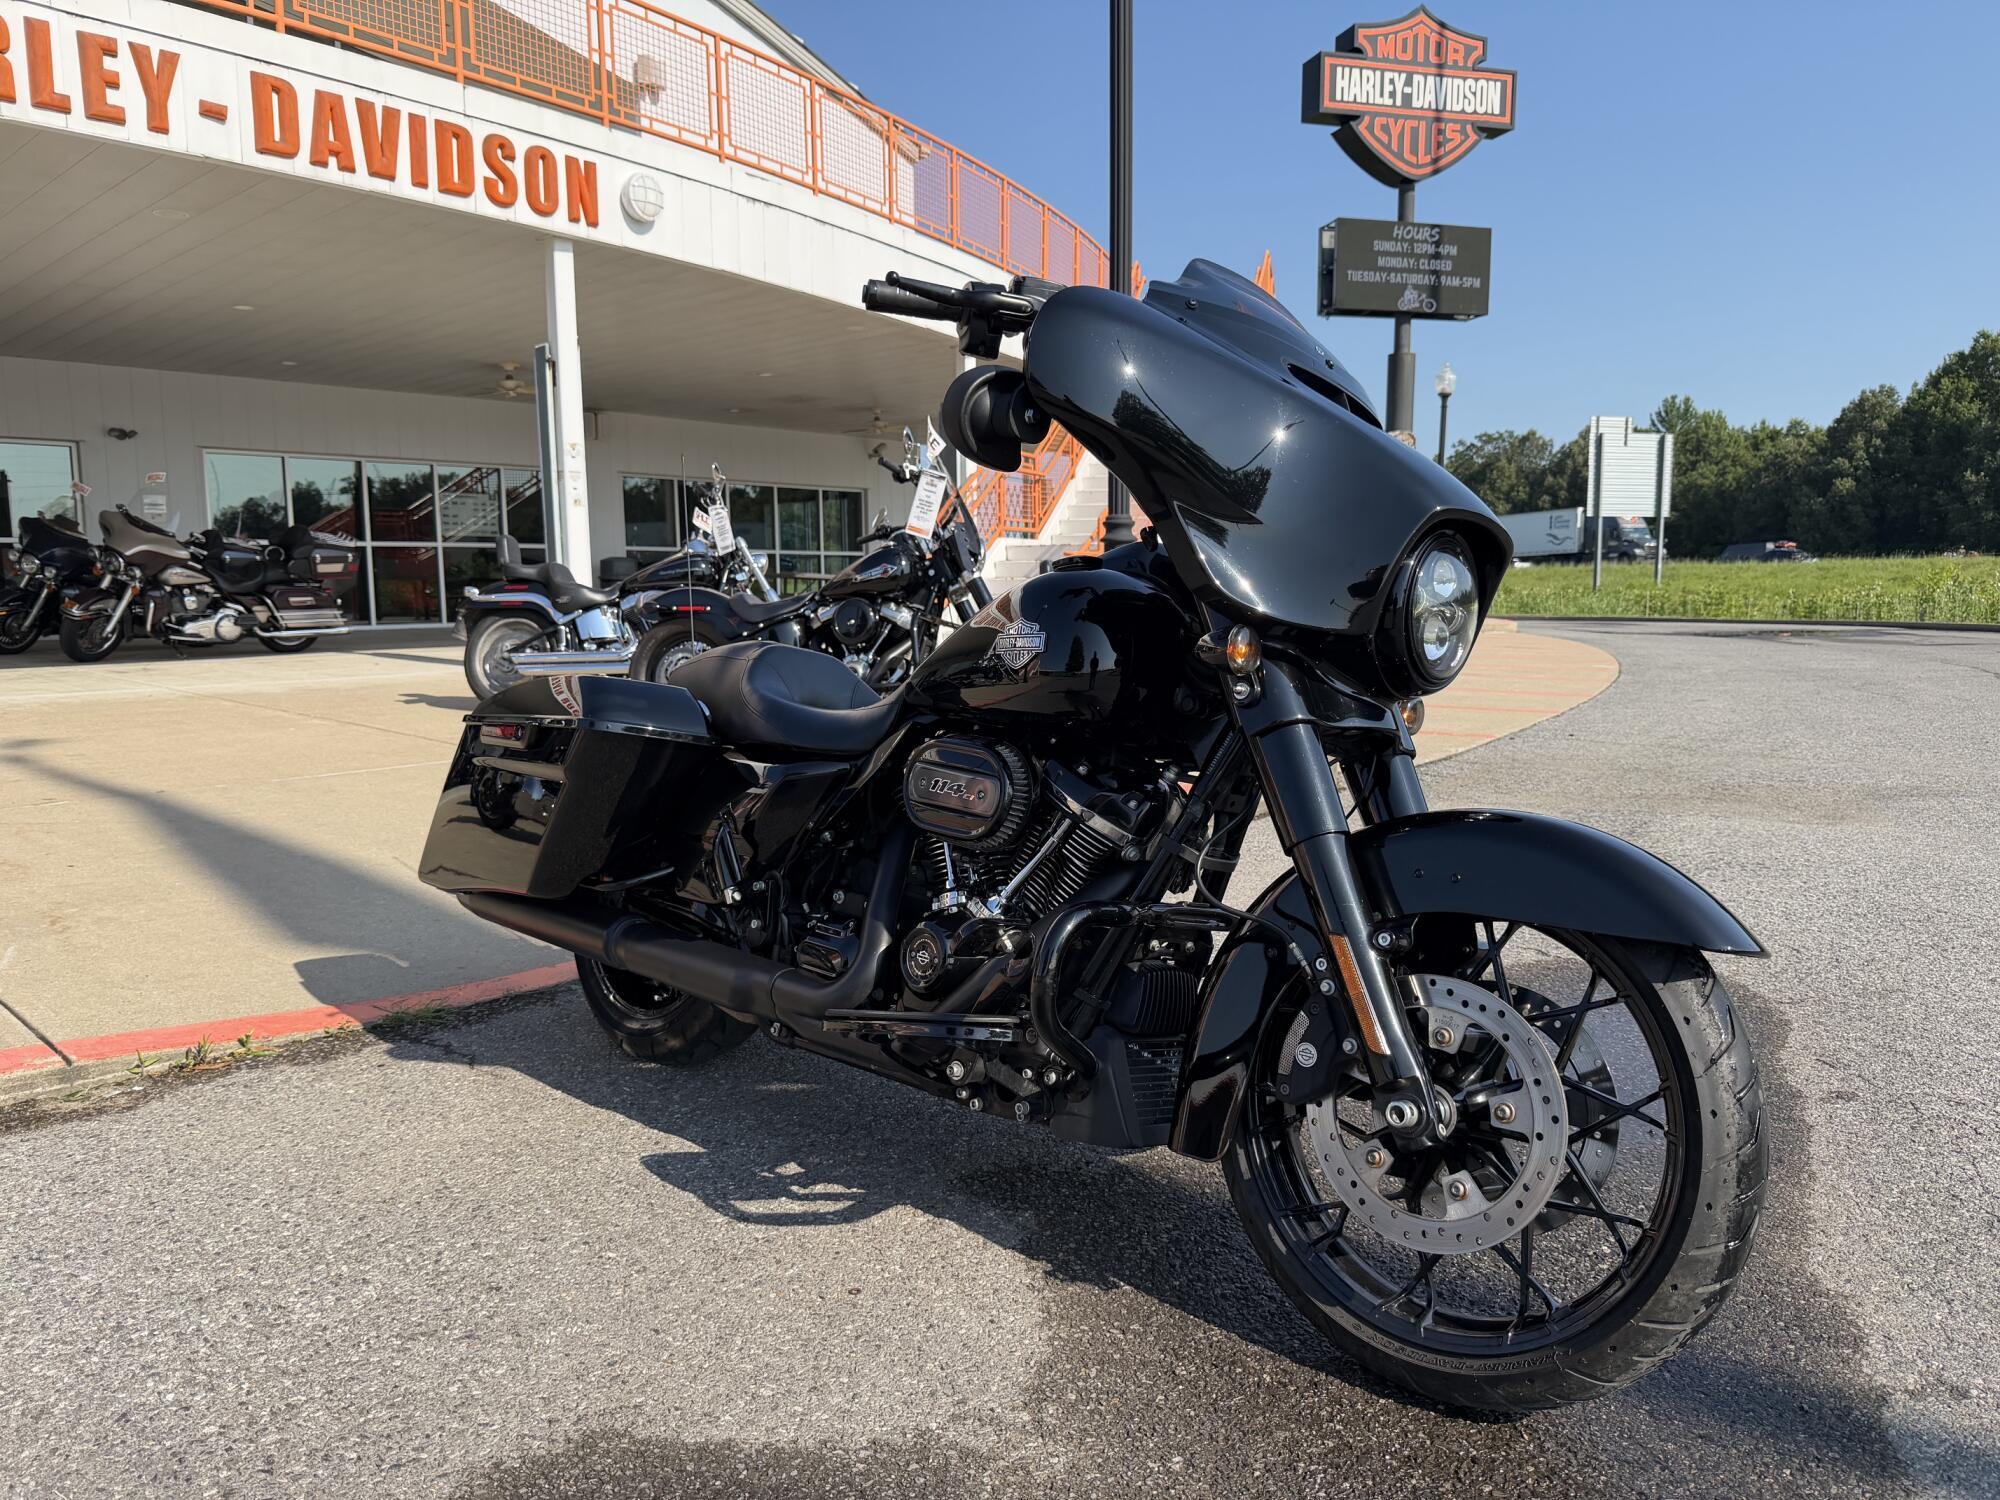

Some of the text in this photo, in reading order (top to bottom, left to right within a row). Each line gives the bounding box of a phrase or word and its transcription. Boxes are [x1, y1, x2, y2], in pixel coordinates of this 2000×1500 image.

[1377, 24, 1465, 66] MOTOR
[1335, 66, 1501, 115] HARLEY-DAVIDSON
[1373, 116, 1462, 165] CYCLES
[1392, 225, 1441, 242] HOURS
[1373, 240, 1458, 257] SUNDAY: 12PM-4PM
[1377, 256, 1453, 272] MONDAY: CLOSED
[1347, 270, 1481, 288] TUESDAY-SATURDAY: 9AM-5PM
[1010, 624, 1031, 634] MOTOR
[929, 777, 967, 797] 114
